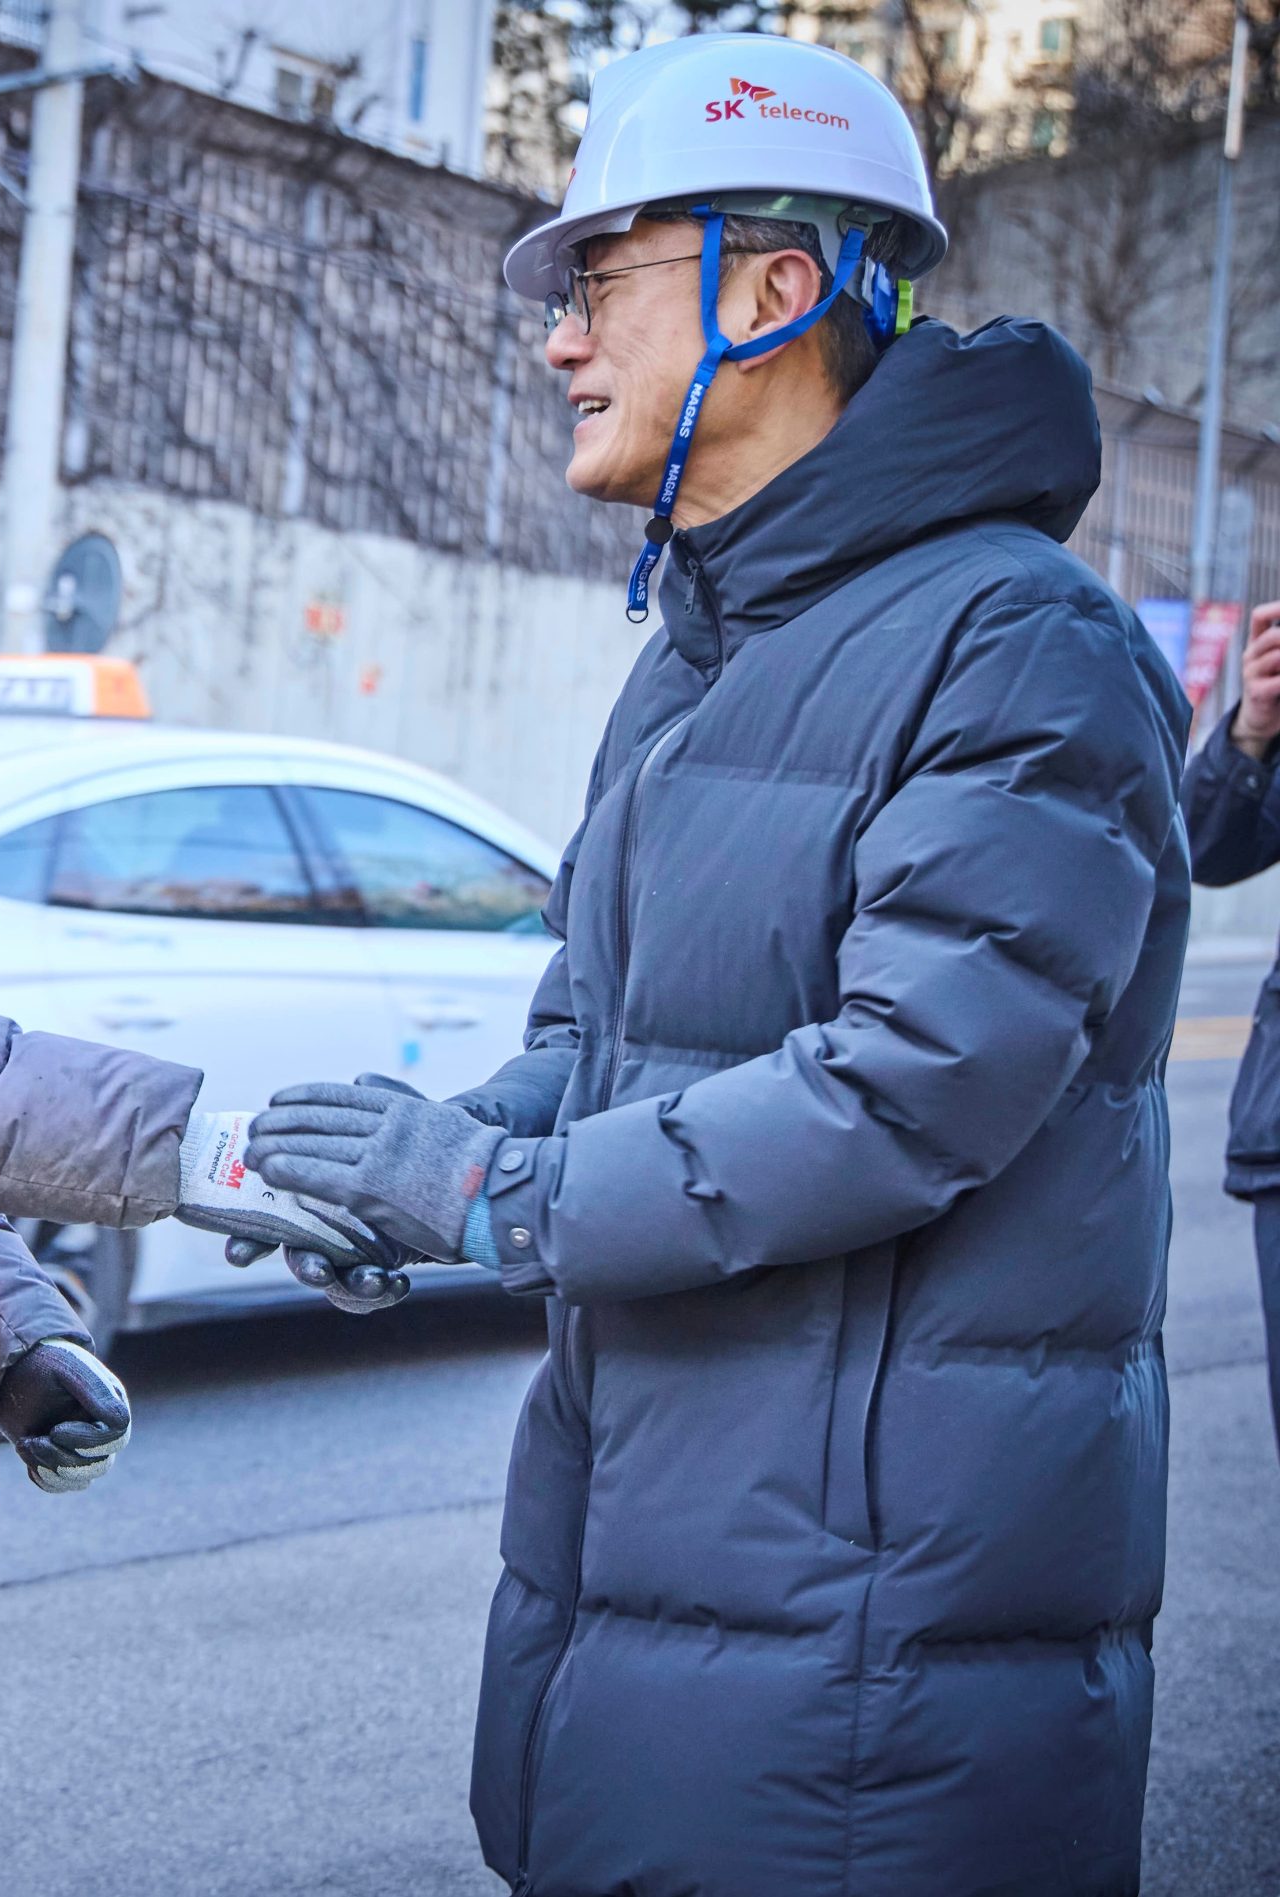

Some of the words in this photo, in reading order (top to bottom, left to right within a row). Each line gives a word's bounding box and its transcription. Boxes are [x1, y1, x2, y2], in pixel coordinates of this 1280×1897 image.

[705, 98, 746, 122] SK
[758, 102, 849, 131] telecom
[679, 382, 704, 438] MAGAS
[661, 463, 681, 504] MAGAS
[636, 554, 657, 602] MAGAS
[225, 1151, 233, 1161] No
[228, 1133, 238, 1149] Grip
[225, 1159, 246, 1190] 3M
